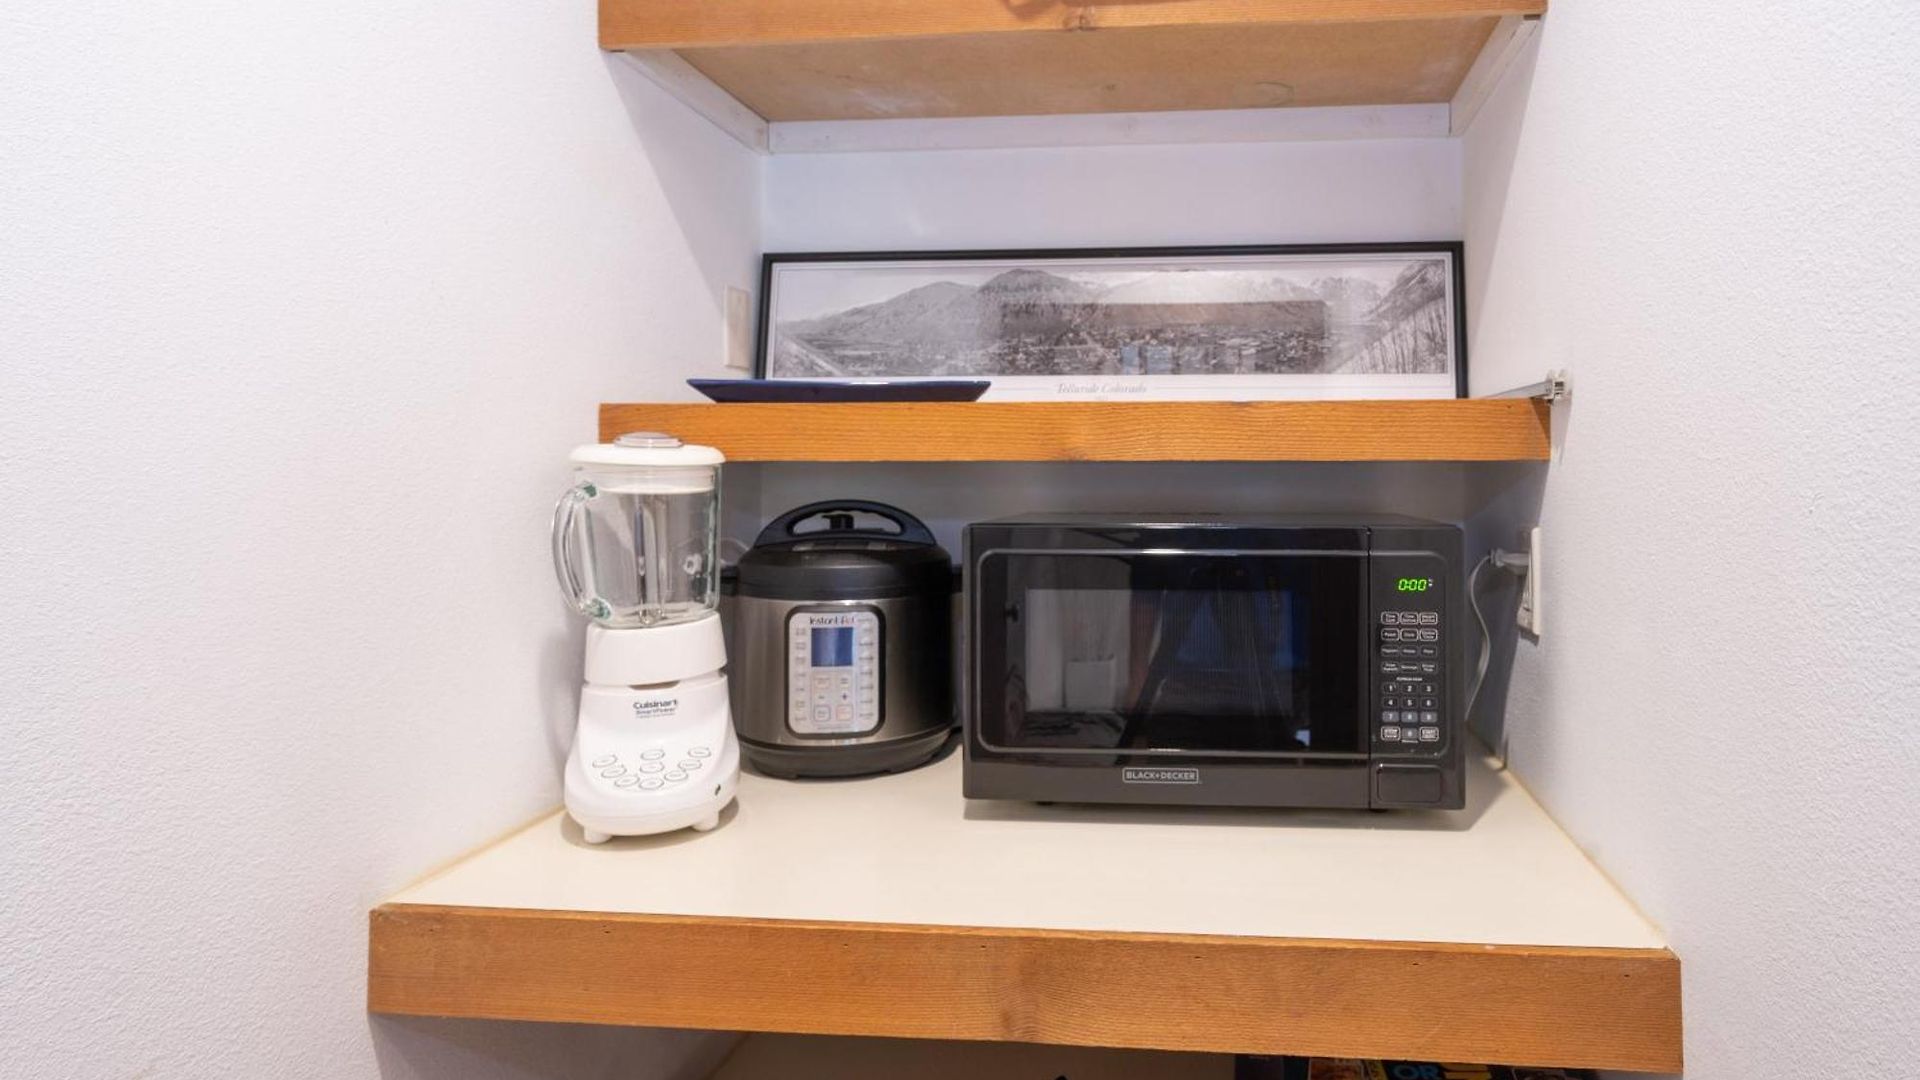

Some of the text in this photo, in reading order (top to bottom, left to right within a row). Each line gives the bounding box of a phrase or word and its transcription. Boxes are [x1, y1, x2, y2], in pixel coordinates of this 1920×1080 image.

[1398, 578, 1427, 591] 0:00
[809, 615, 838, 625] Instant
[632, 699, 677, 709] Cuisinart
